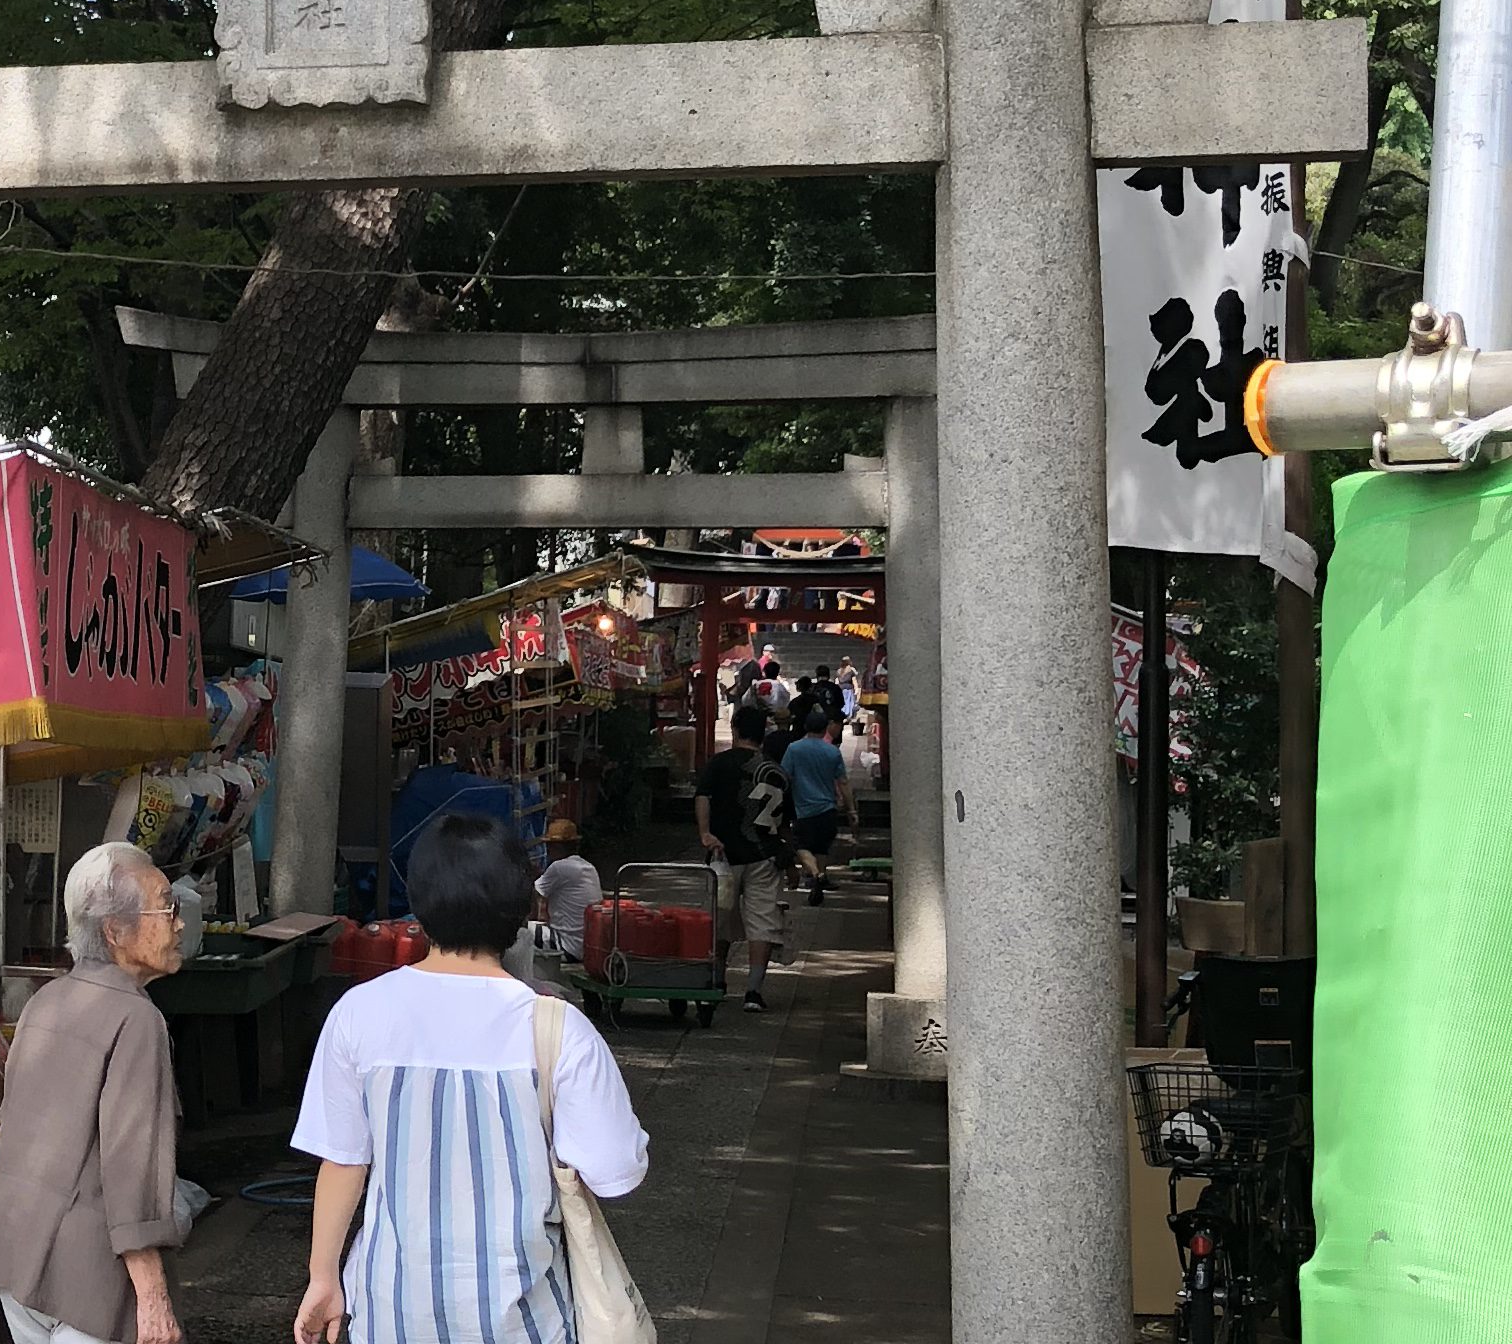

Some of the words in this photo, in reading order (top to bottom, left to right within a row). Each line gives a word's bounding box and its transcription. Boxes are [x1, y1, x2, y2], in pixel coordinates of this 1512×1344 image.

[64, 511, 182, 689] じゃがバター
